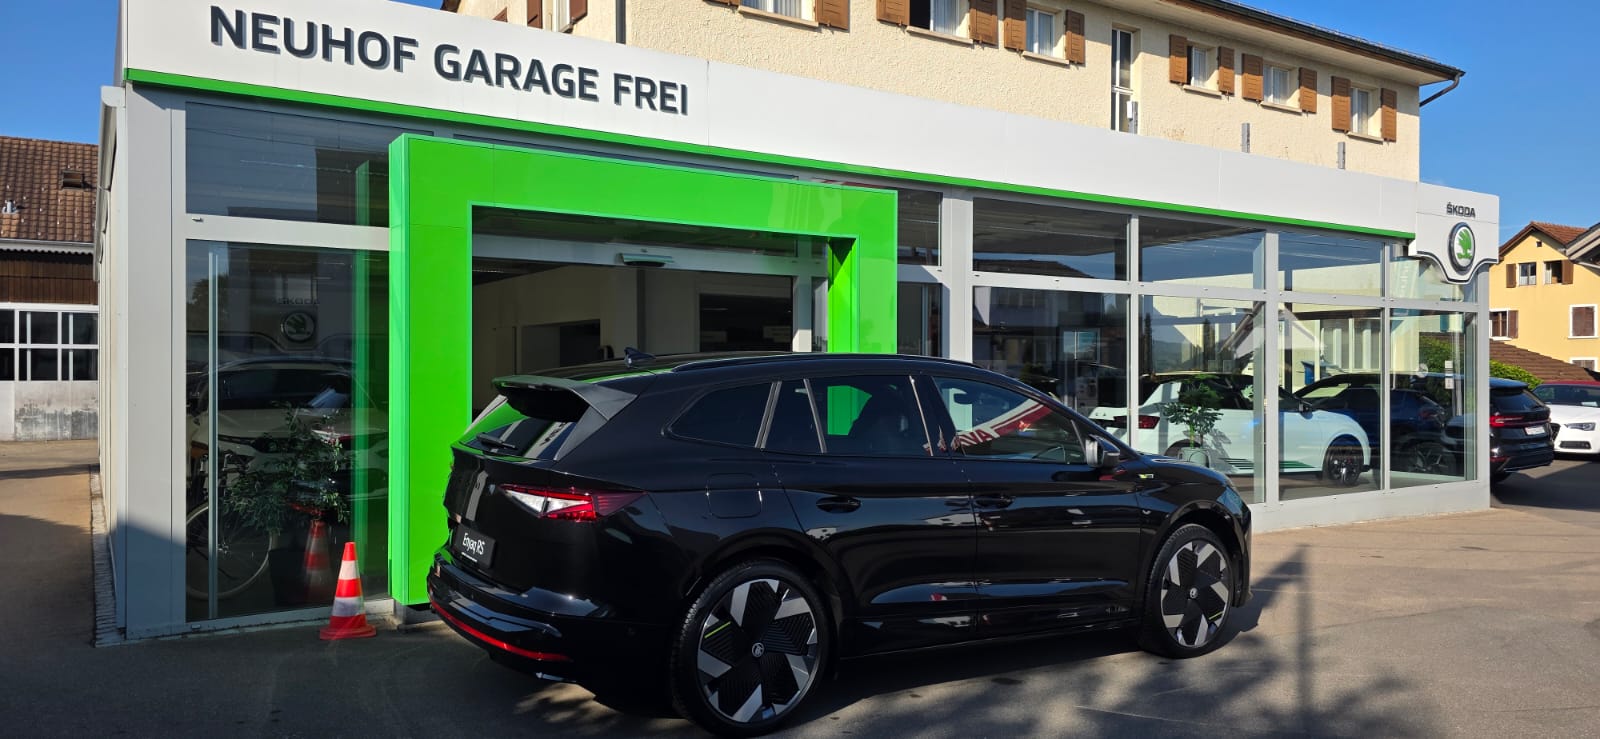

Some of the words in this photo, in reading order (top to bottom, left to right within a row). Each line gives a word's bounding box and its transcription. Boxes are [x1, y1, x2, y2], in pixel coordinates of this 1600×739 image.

[211, 5, 419, 73] NEUHOF
[434, 43, 600, 102] GARAGE
[613, 73, 688, 116] FREI
[1446, 201, 1476, 219] ŠKODA
[462, 532, 477, 555] Enyaq
[476, 539, 486, 556] RS
